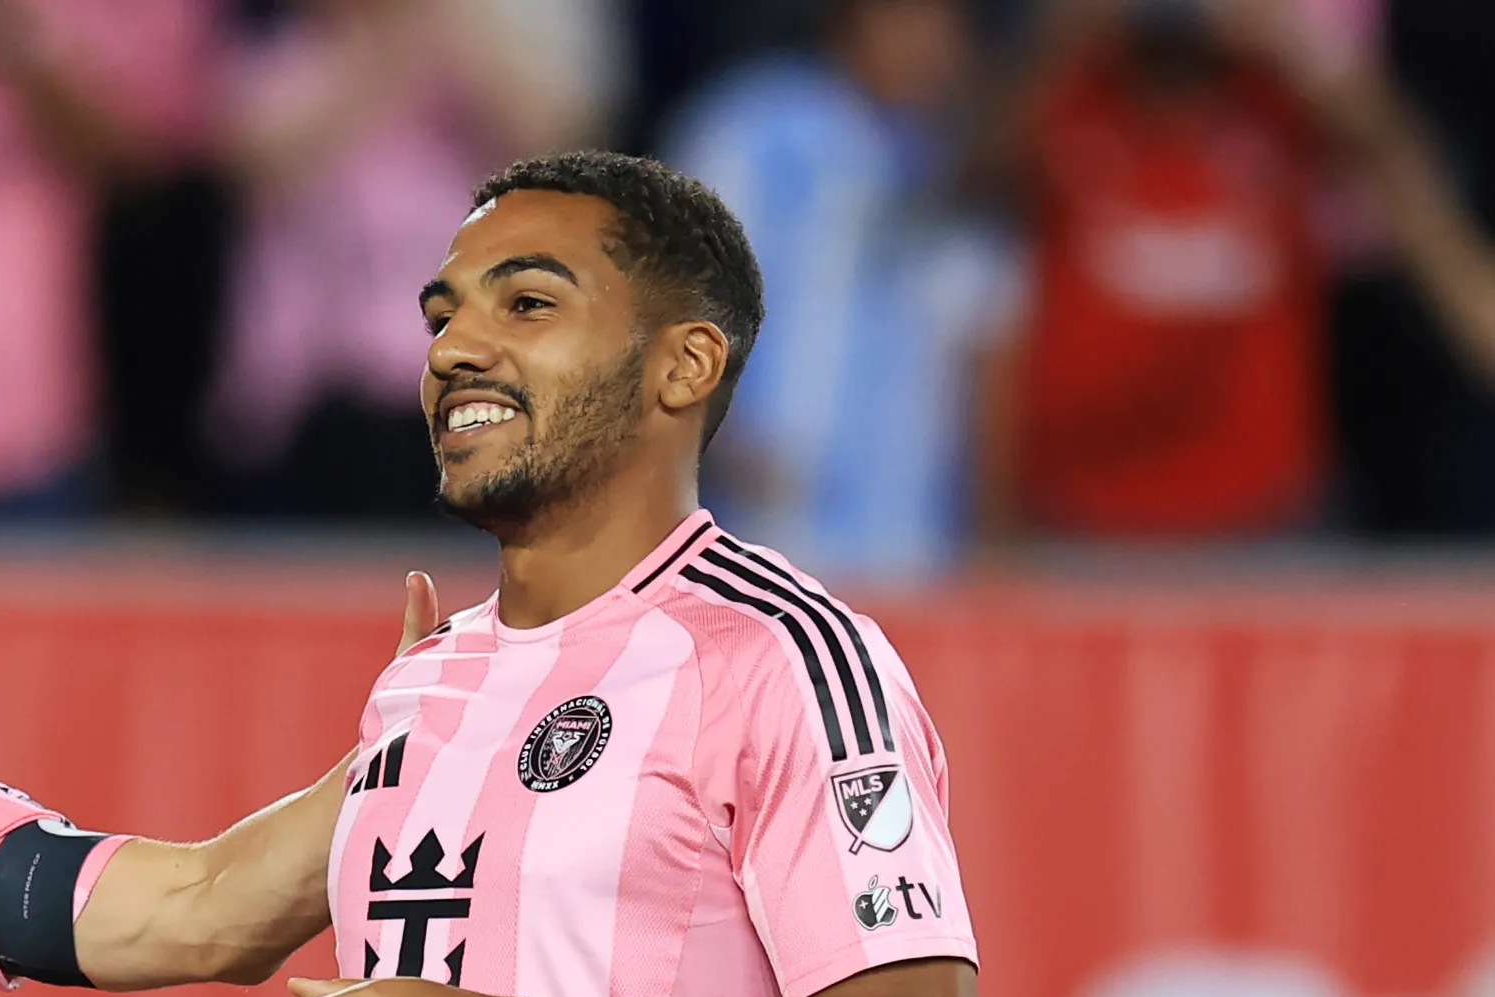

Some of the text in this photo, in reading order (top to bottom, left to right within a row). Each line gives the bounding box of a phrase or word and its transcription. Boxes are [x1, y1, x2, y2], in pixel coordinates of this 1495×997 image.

[555, 721, 593, 731] MIAMI
[841, 775, 884, 800] MLS
[896, 876, 942, 920] tv
